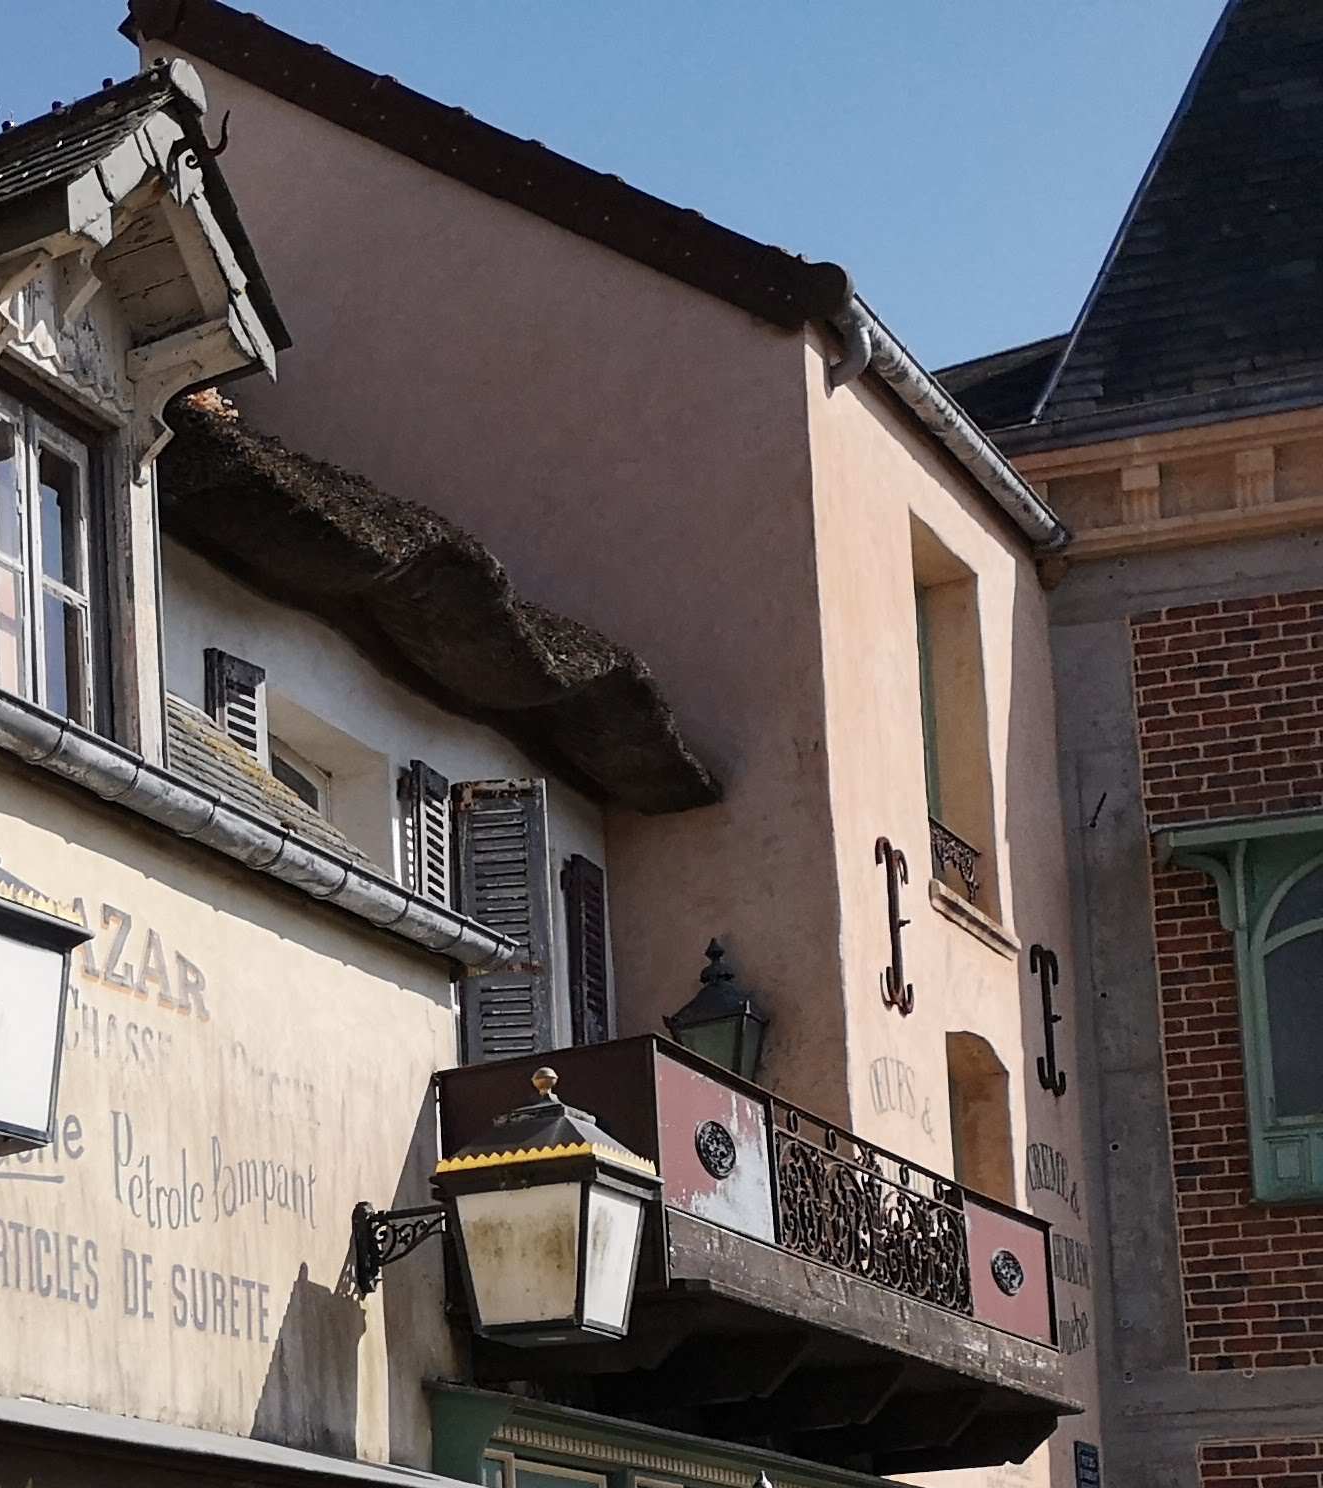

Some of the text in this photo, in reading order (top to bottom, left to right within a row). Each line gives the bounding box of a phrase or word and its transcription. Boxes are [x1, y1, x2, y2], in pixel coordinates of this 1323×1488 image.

[72, 897, 210, 1022] AZAR
[112, 1110, 204, 1230] Pétrole
[213, 1135, 317, 1230] lampant
[124, 1248, 154, 1320] DE
[172, 1264, 271, 1344] SURETE
